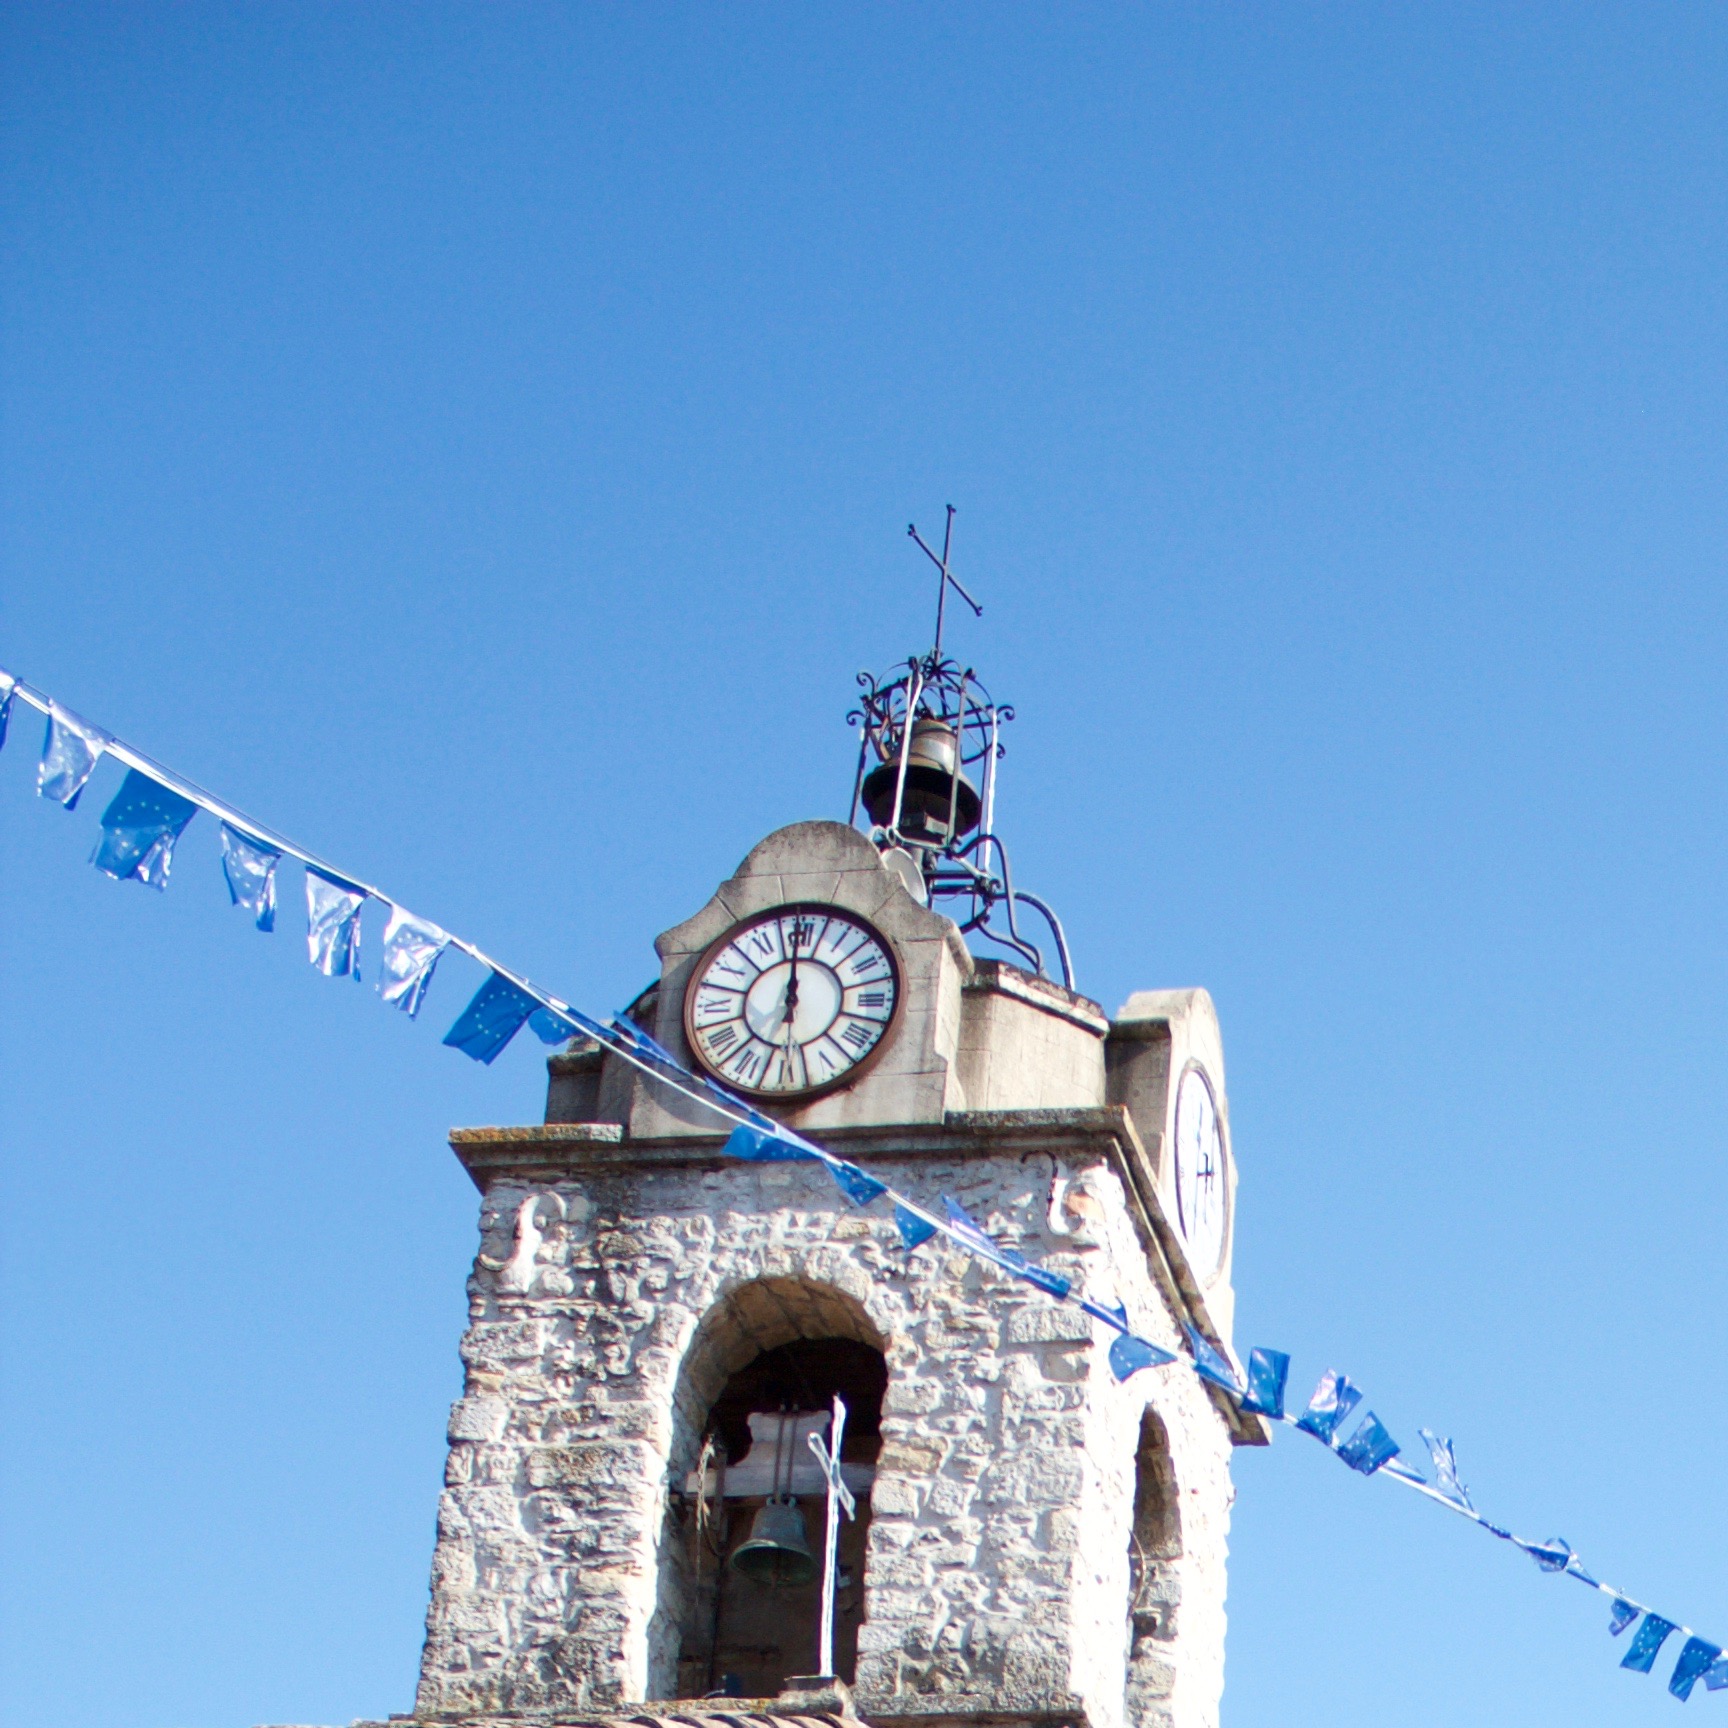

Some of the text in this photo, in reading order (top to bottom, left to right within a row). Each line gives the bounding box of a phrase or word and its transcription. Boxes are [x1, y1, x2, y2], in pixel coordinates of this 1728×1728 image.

[750, 932, 774, 957] XI
[720, 962, 745, 981] X
[704, 997, 731, 1015] IX
[858, 994, 885, 1007] III
